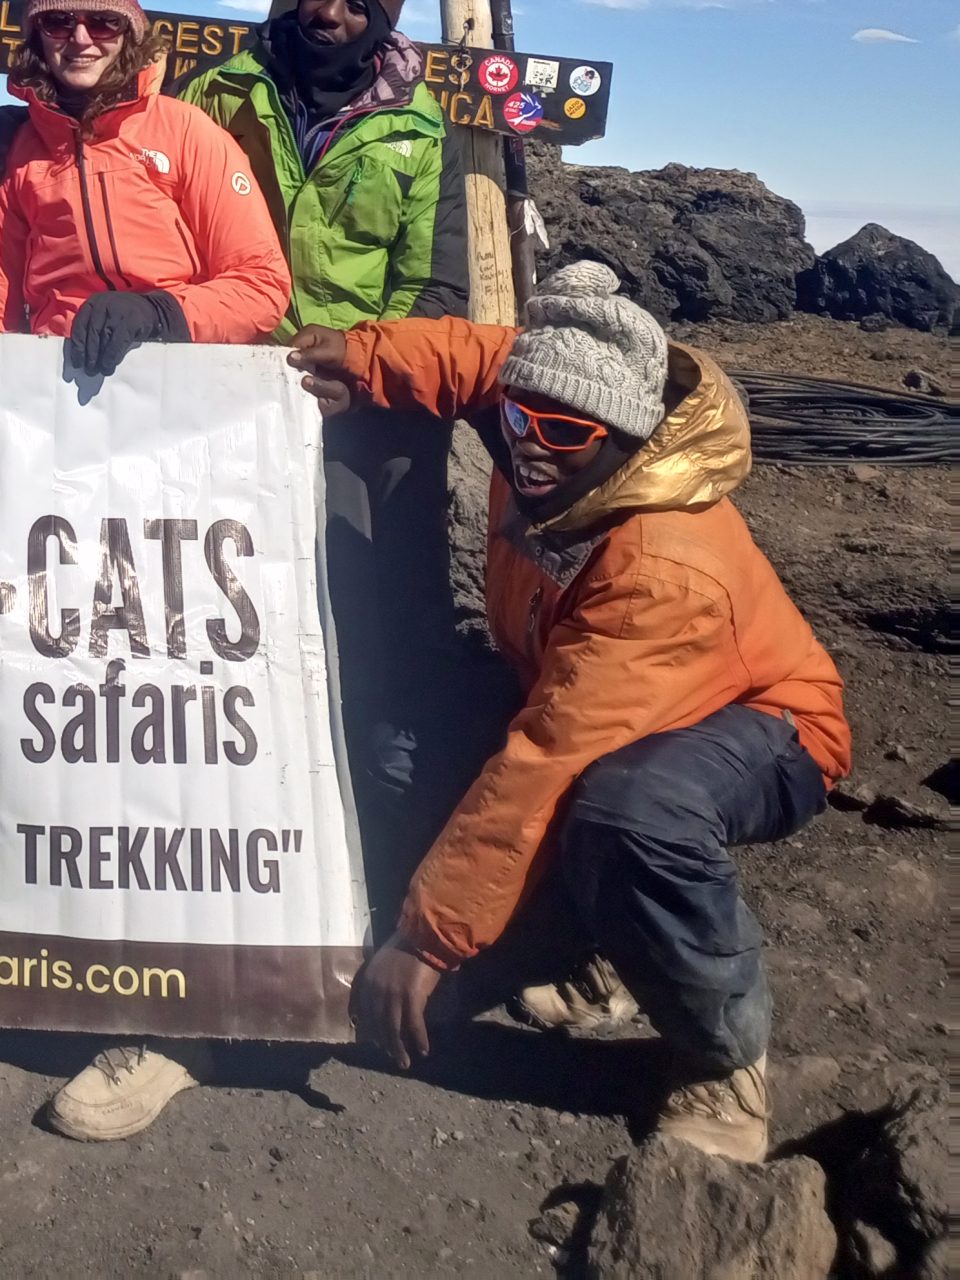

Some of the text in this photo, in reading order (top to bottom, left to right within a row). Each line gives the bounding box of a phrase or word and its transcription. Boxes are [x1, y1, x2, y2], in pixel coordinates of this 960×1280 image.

[153, 19, 249, 56] GEST
[425, 50, 473, 85] ES
[484, 56, 514, 71] CANADA
[508, 101, 525, 109] 425
[141, 148, 157, 157] THE
[26, 515, 260, 661] CATS
[21, 661, 258, 765] safaris
[17, 824, 303, 893] TREKKING"
